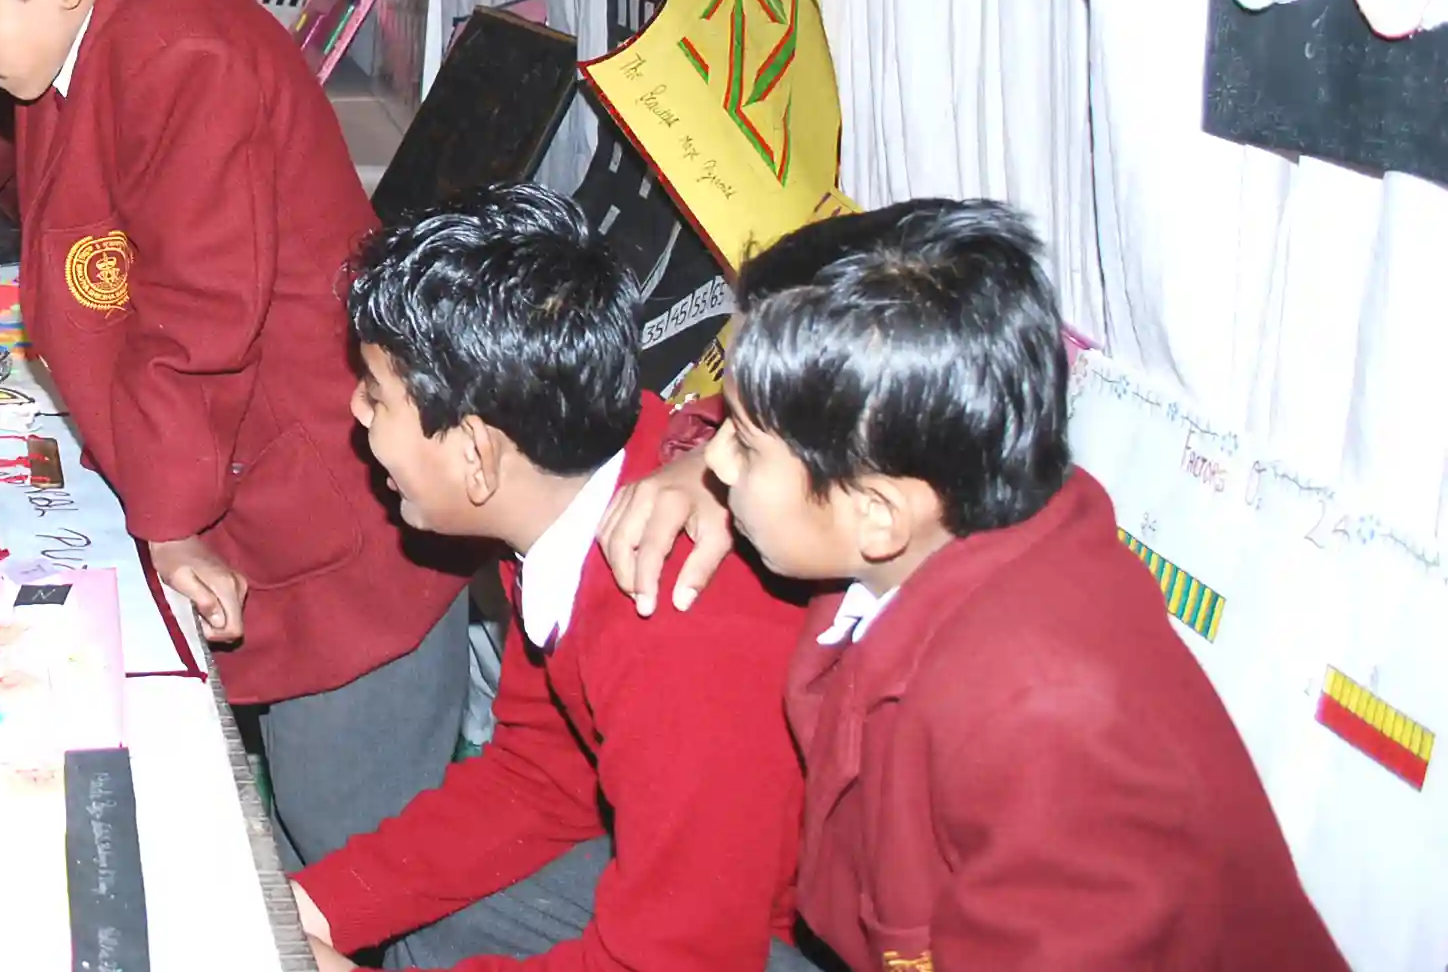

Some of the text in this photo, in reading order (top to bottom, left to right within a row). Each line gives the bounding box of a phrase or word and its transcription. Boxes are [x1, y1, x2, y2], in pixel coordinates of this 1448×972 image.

[645, 319, 665, 346] 35
[670, 300, 688, 327] 45
[691, 288, 709, 319] 55
